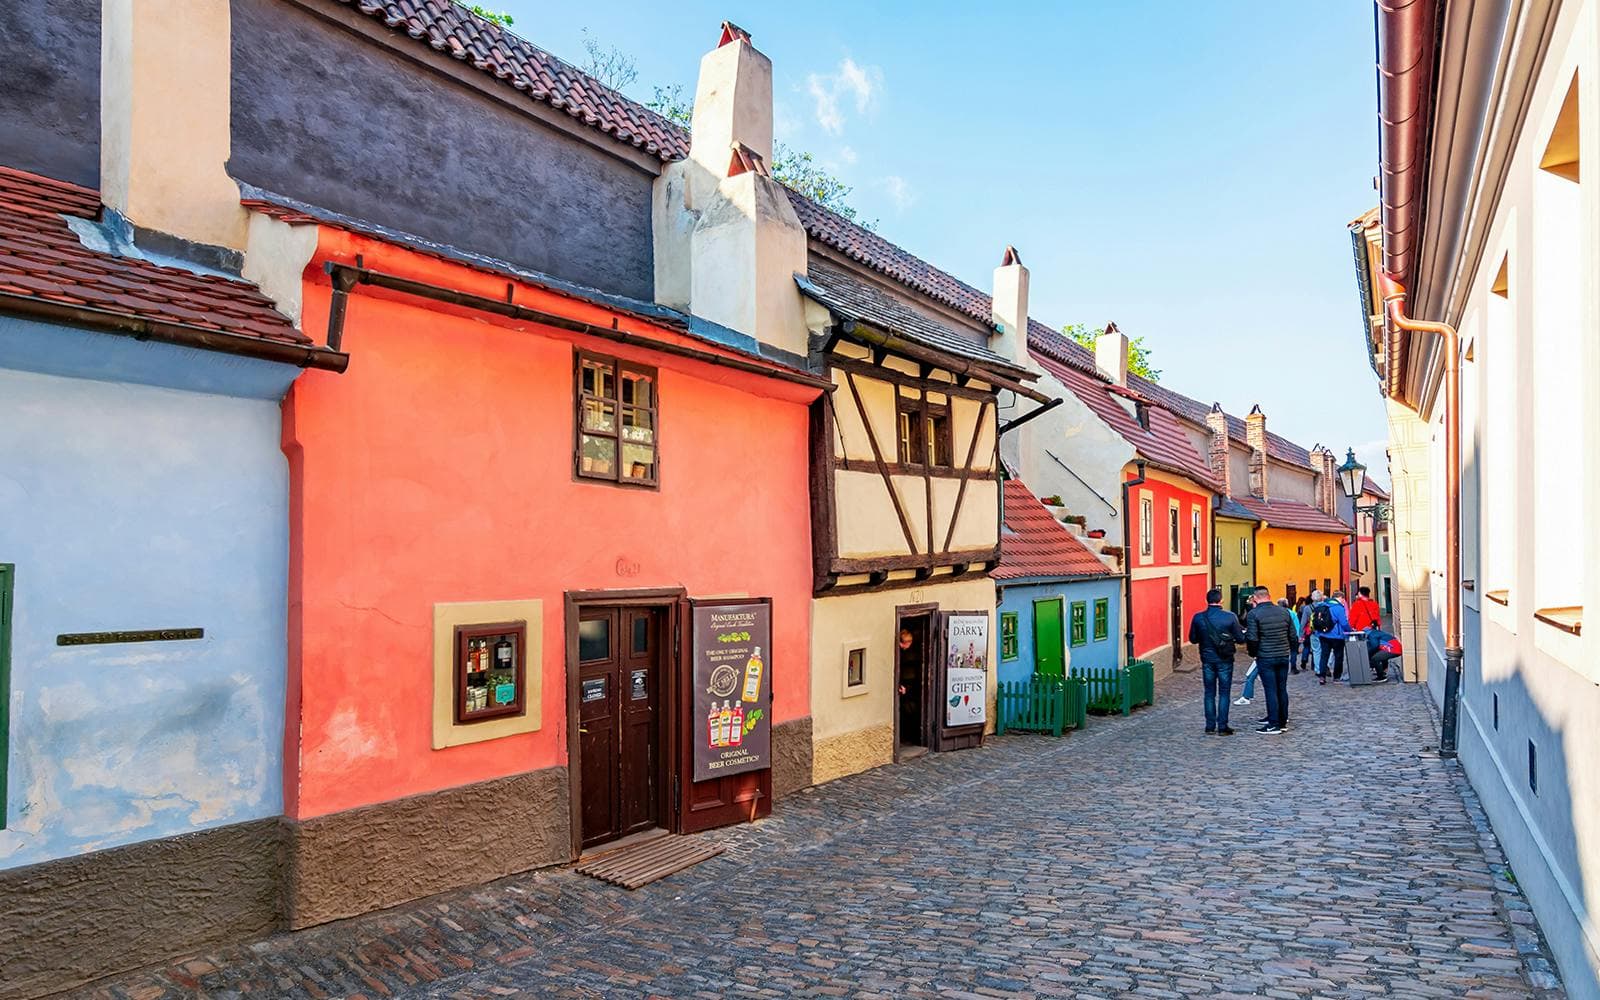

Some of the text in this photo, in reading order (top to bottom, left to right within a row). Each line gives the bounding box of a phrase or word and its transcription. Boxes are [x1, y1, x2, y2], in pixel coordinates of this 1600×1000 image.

[953, 624, 983, 636] DÁRKY
[952, 682, 982, 693] GIFTS
[720, 749, 749, 759] ORIGINAL
[725, 755, 759, 767] COSMETICS
